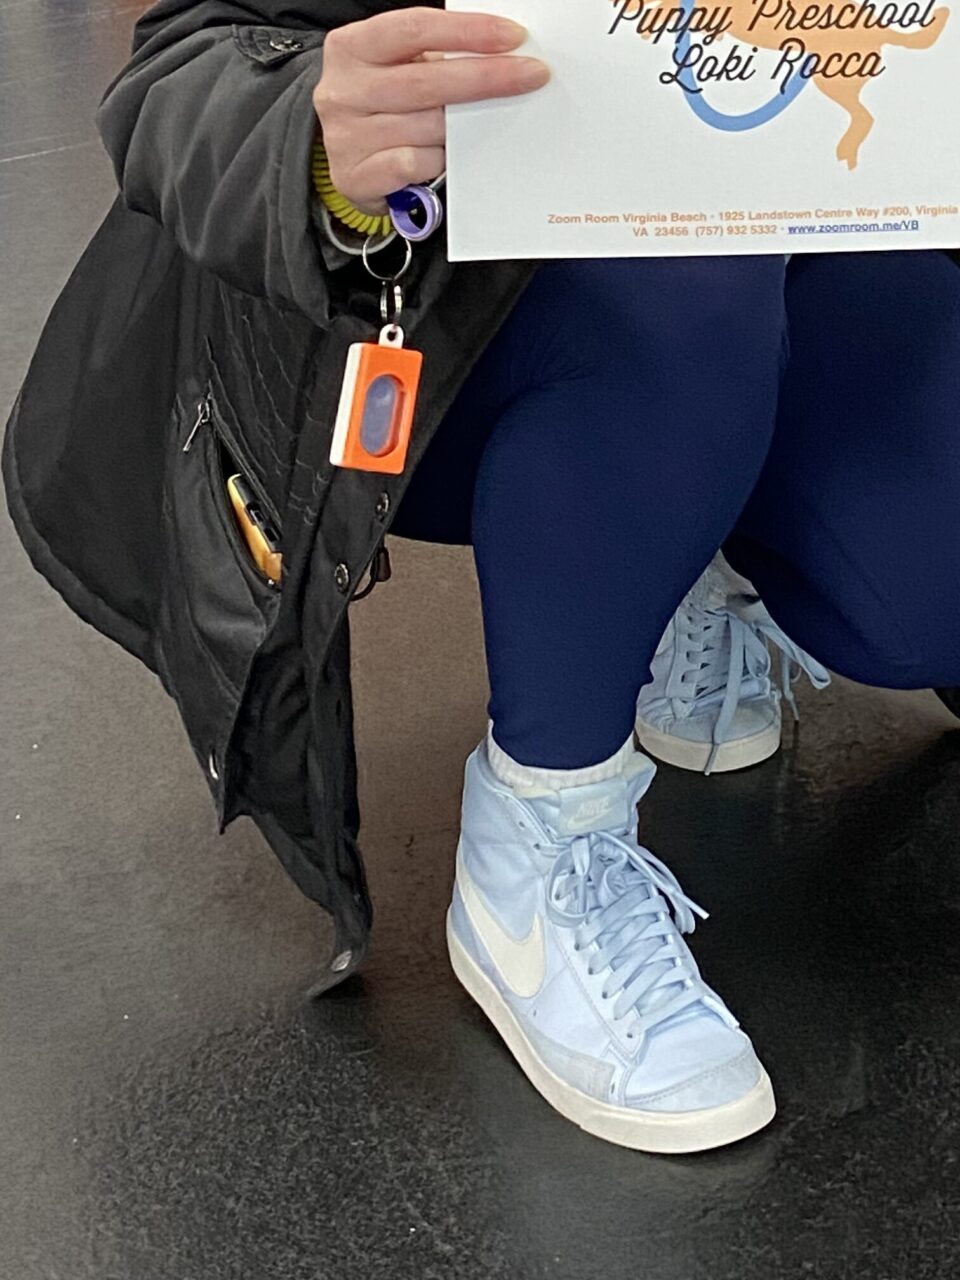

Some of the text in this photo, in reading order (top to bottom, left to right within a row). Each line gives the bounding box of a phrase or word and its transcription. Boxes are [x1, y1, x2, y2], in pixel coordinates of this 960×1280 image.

[659, 37, 886, 95] Loki Rocca
[548, 214, 581, 224] Zoom
[585, 214, 619, 224] Room
[623, 213, 668, 225] Virginia
[671, 212, 707, 222] Beach
[718, 211, 745, 221] 1925
[748, 209, 811, 221] Landstown
[815, 208, 852, 219] Centre
[856, 207, 879, 219] Way
[882, 206, 912, 218] #200,
[916, 205, 958, 217] Virginia
[633, 220, 919, 237] VA 23456 (757) 932 5332 www.zoomroom.me/VB
